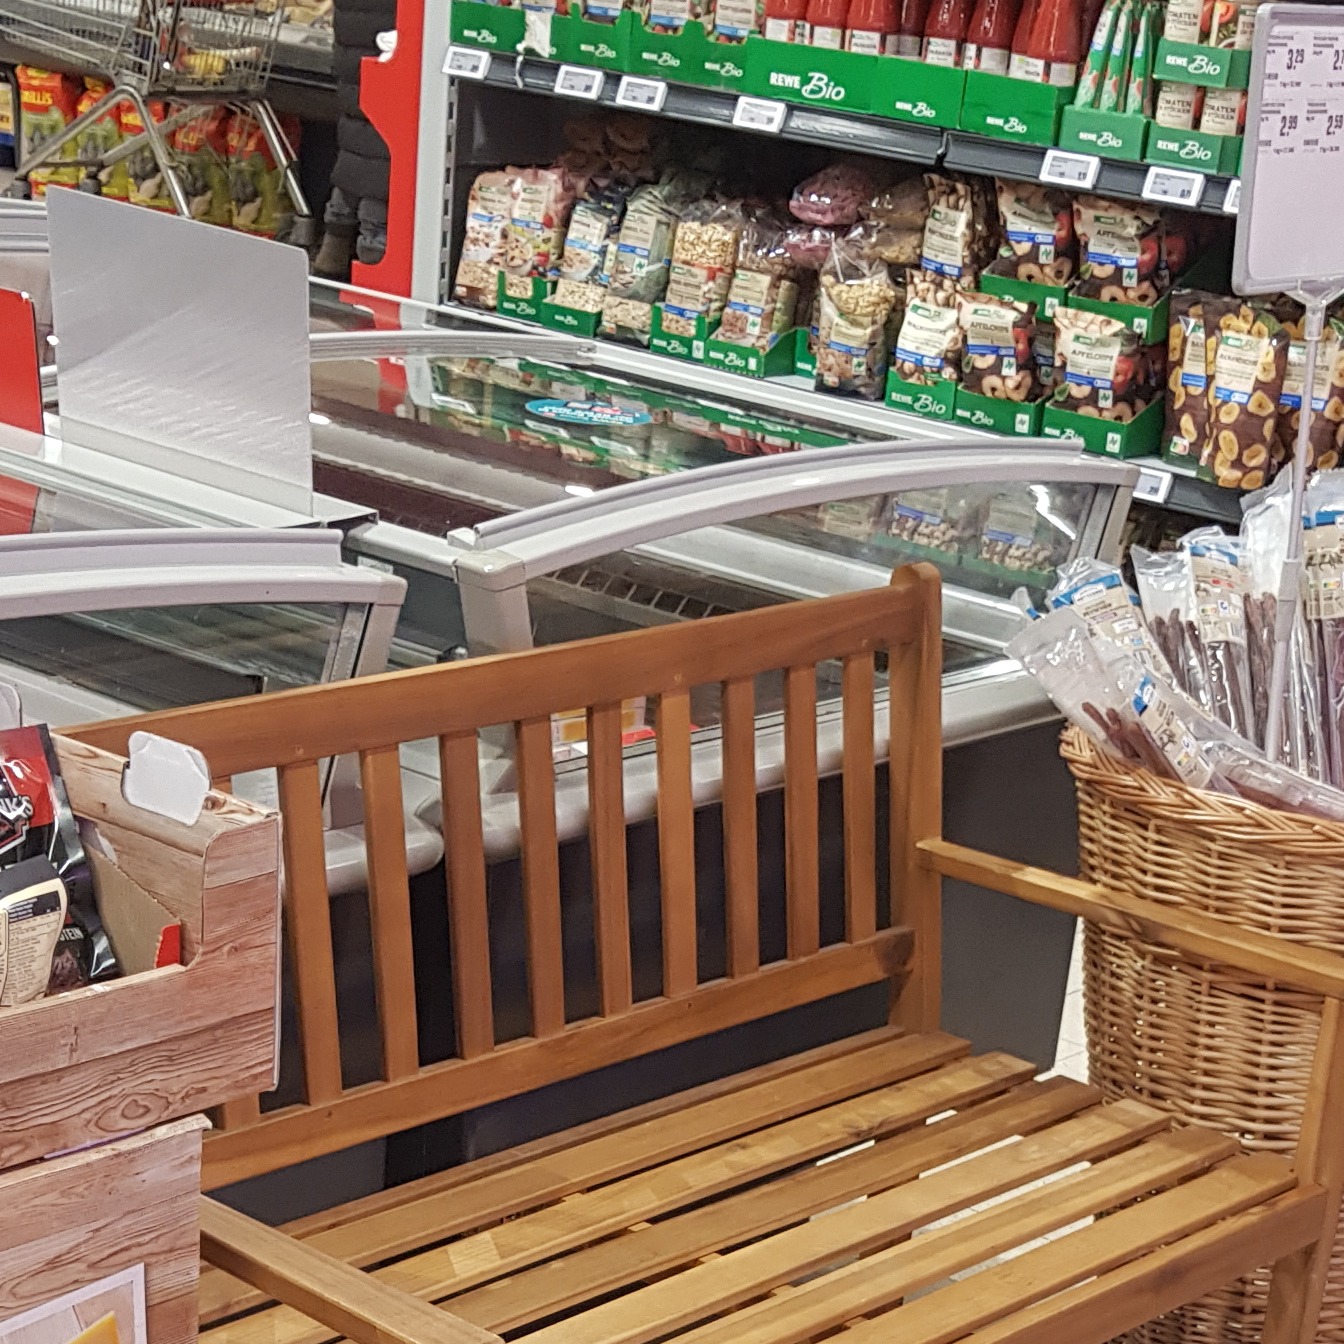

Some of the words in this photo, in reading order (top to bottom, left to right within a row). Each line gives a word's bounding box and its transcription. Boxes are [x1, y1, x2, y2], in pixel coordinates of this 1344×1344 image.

[477, 29, 498, 44] Bio
[594, 43, 616, 58] Bio
[658, 52, 680, 67] Bio
[1165, 55, 1188, 68] REWE
[1188, 54, 1221, 75] Bio
[720, 62, 744, 78] Bio
[770, 71, 801, 90] REWE
[801, 72, 846, 101] Bio
[912, 102, 936, 118] Bio
[1004, 117, 1028, 134] Bio
[1097, 132, 1123, 148] Bio
[1157, 140, 1180, 152] REWE
[1179, 140, 1212, 161] Bio
[667, 339, 689, 355] Bio
[724, 350, 746, 368] Bio
[912, 393, 947, 415] Bio
[970, 410, 994, 427] Bio
